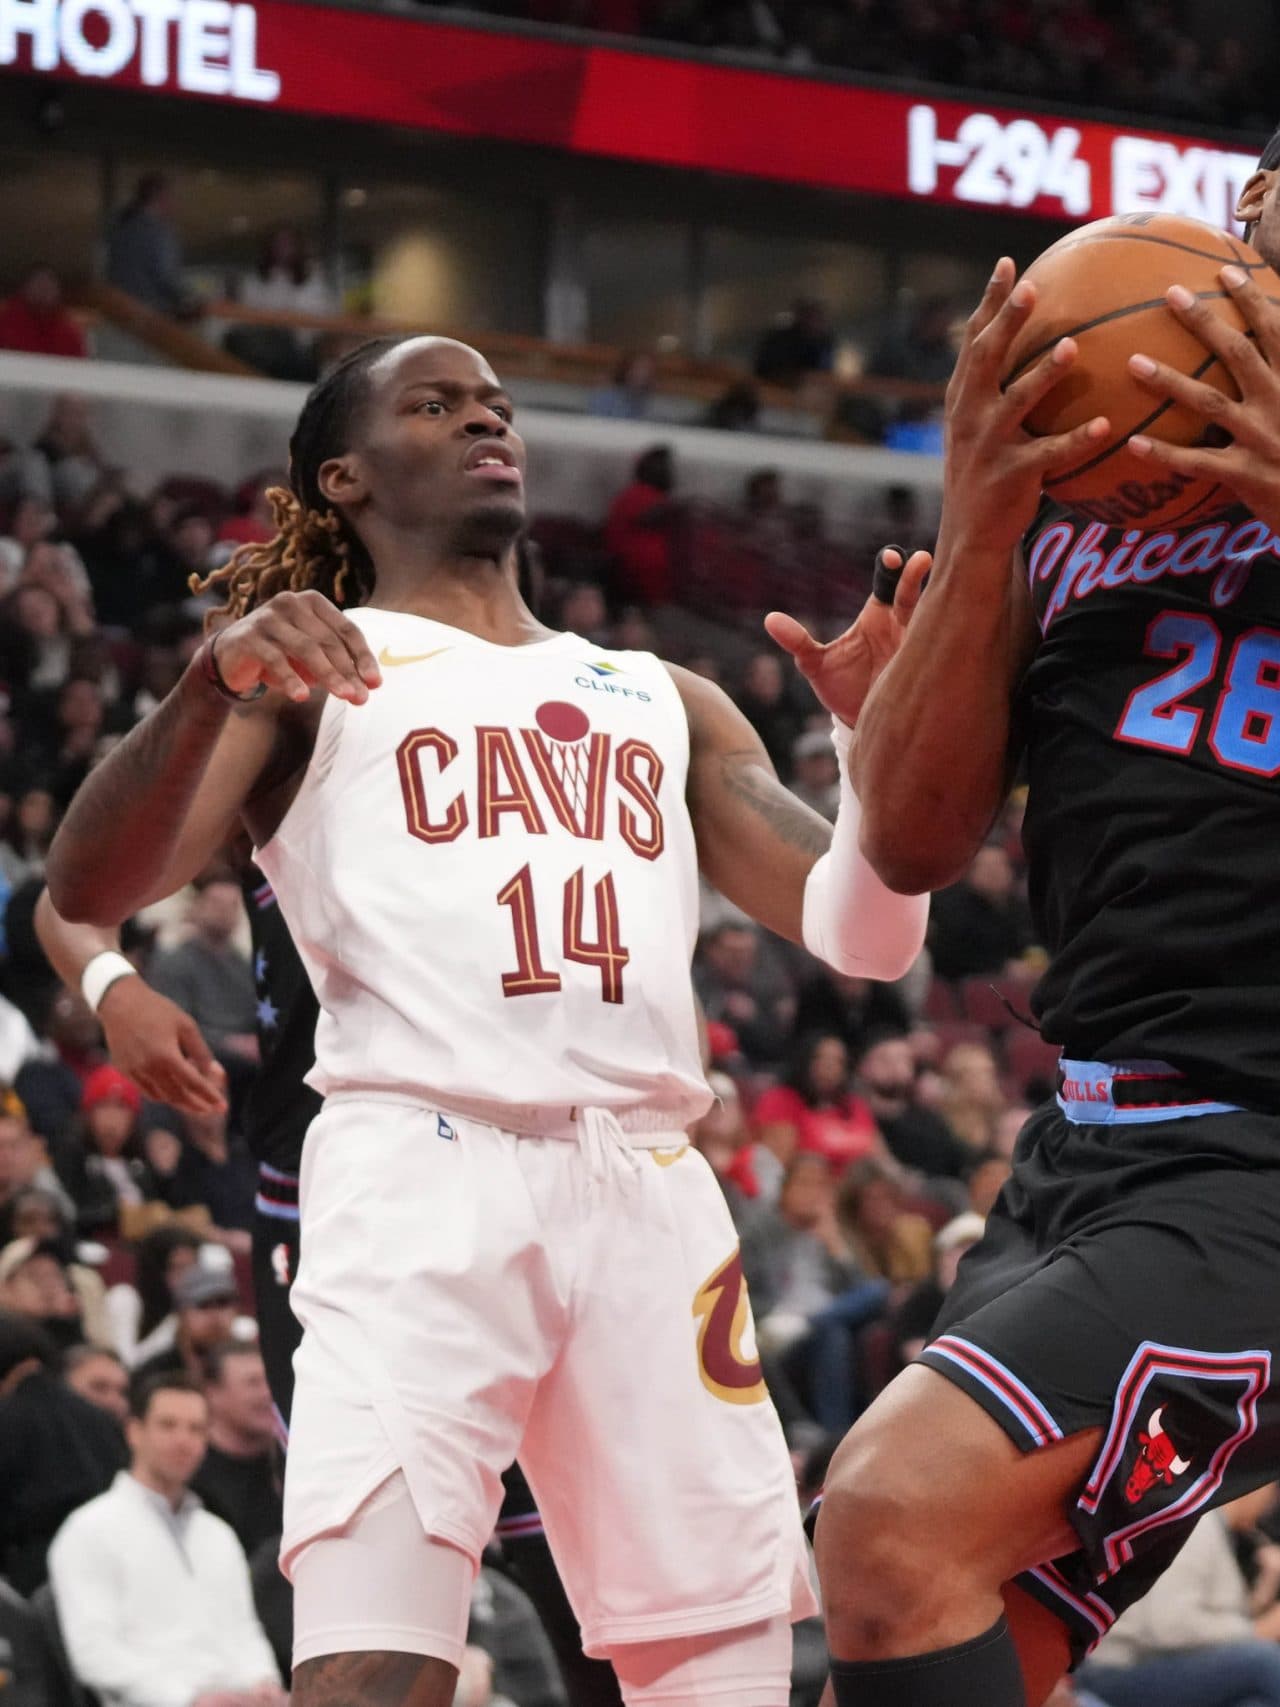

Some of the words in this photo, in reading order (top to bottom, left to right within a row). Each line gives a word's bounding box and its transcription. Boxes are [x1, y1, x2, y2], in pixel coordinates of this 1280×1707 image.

[0, 0, 281, 102] HOTEL
[906, 104, 1092, 216] I-294
[574, 675, 653, 703] CLIFFS
[395, 725, 665, 863] CAVS
[495, 861, 630, 1005] 14
